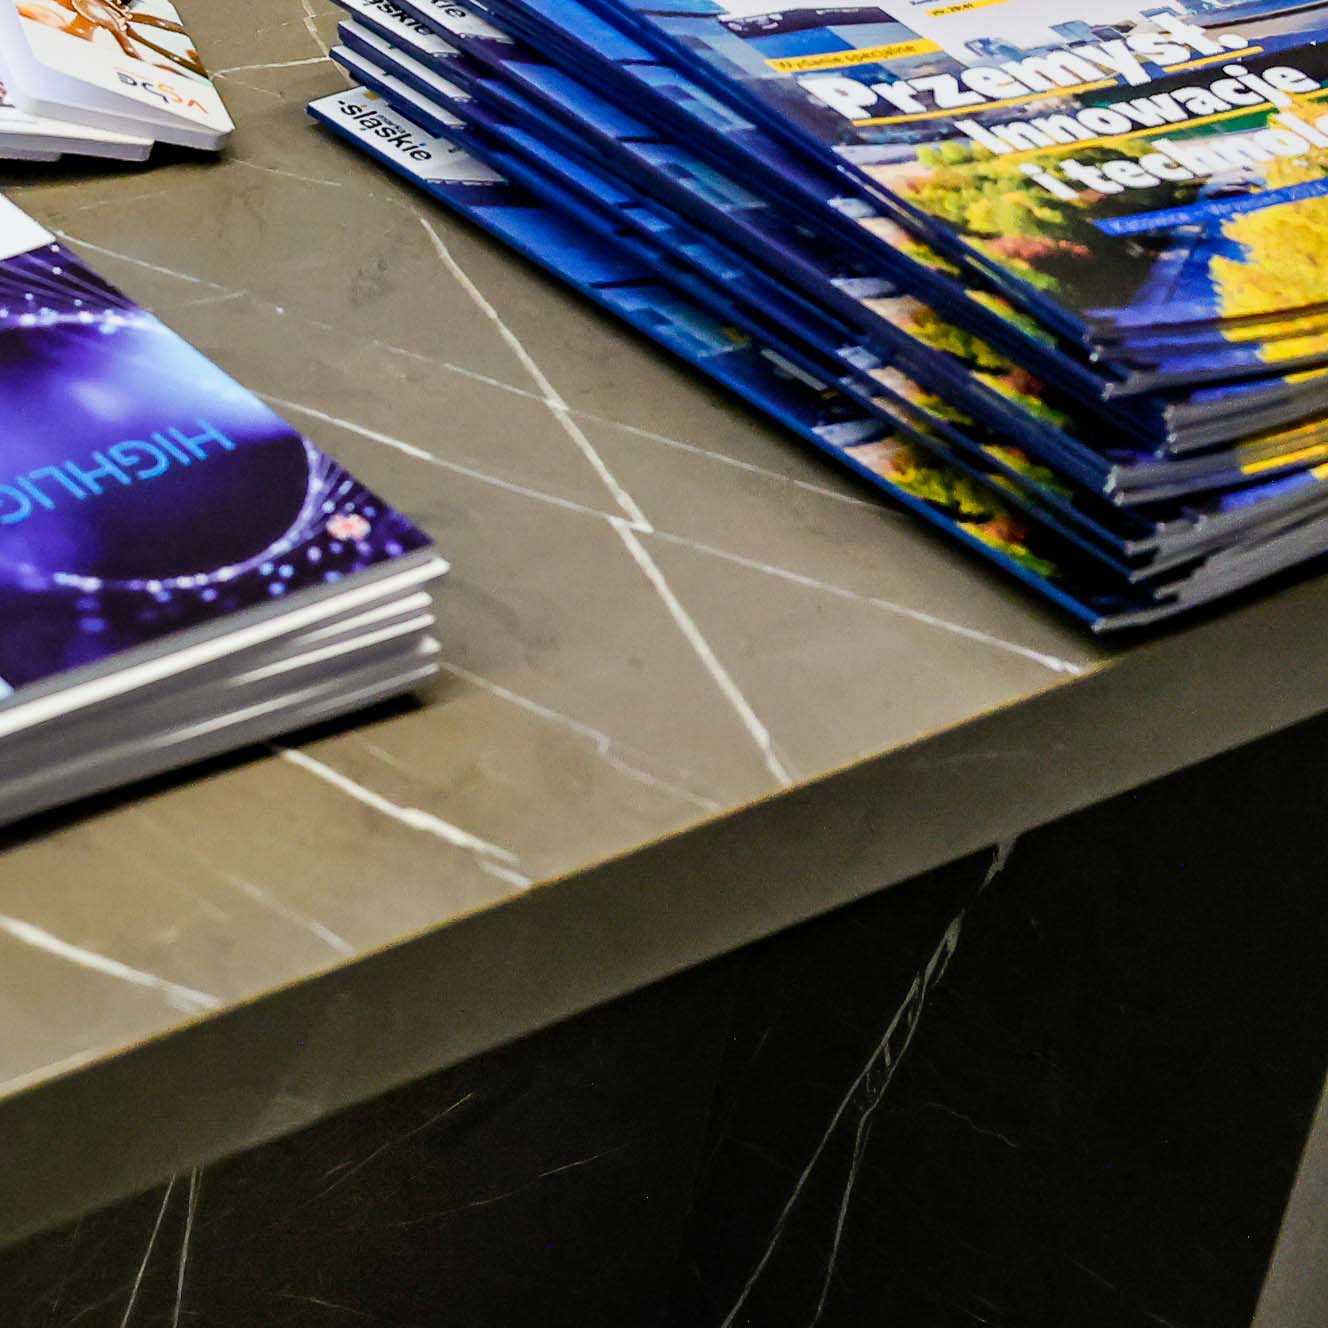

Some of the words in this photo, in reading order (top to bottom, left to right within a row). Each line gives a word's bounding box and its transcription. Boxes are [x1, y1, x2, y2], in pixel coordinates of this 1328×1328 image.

[954, 64, 1321, 154] Innowacje
[1019, 162, 1079, 201] i
[1073, 112, 1328, 195] technol
